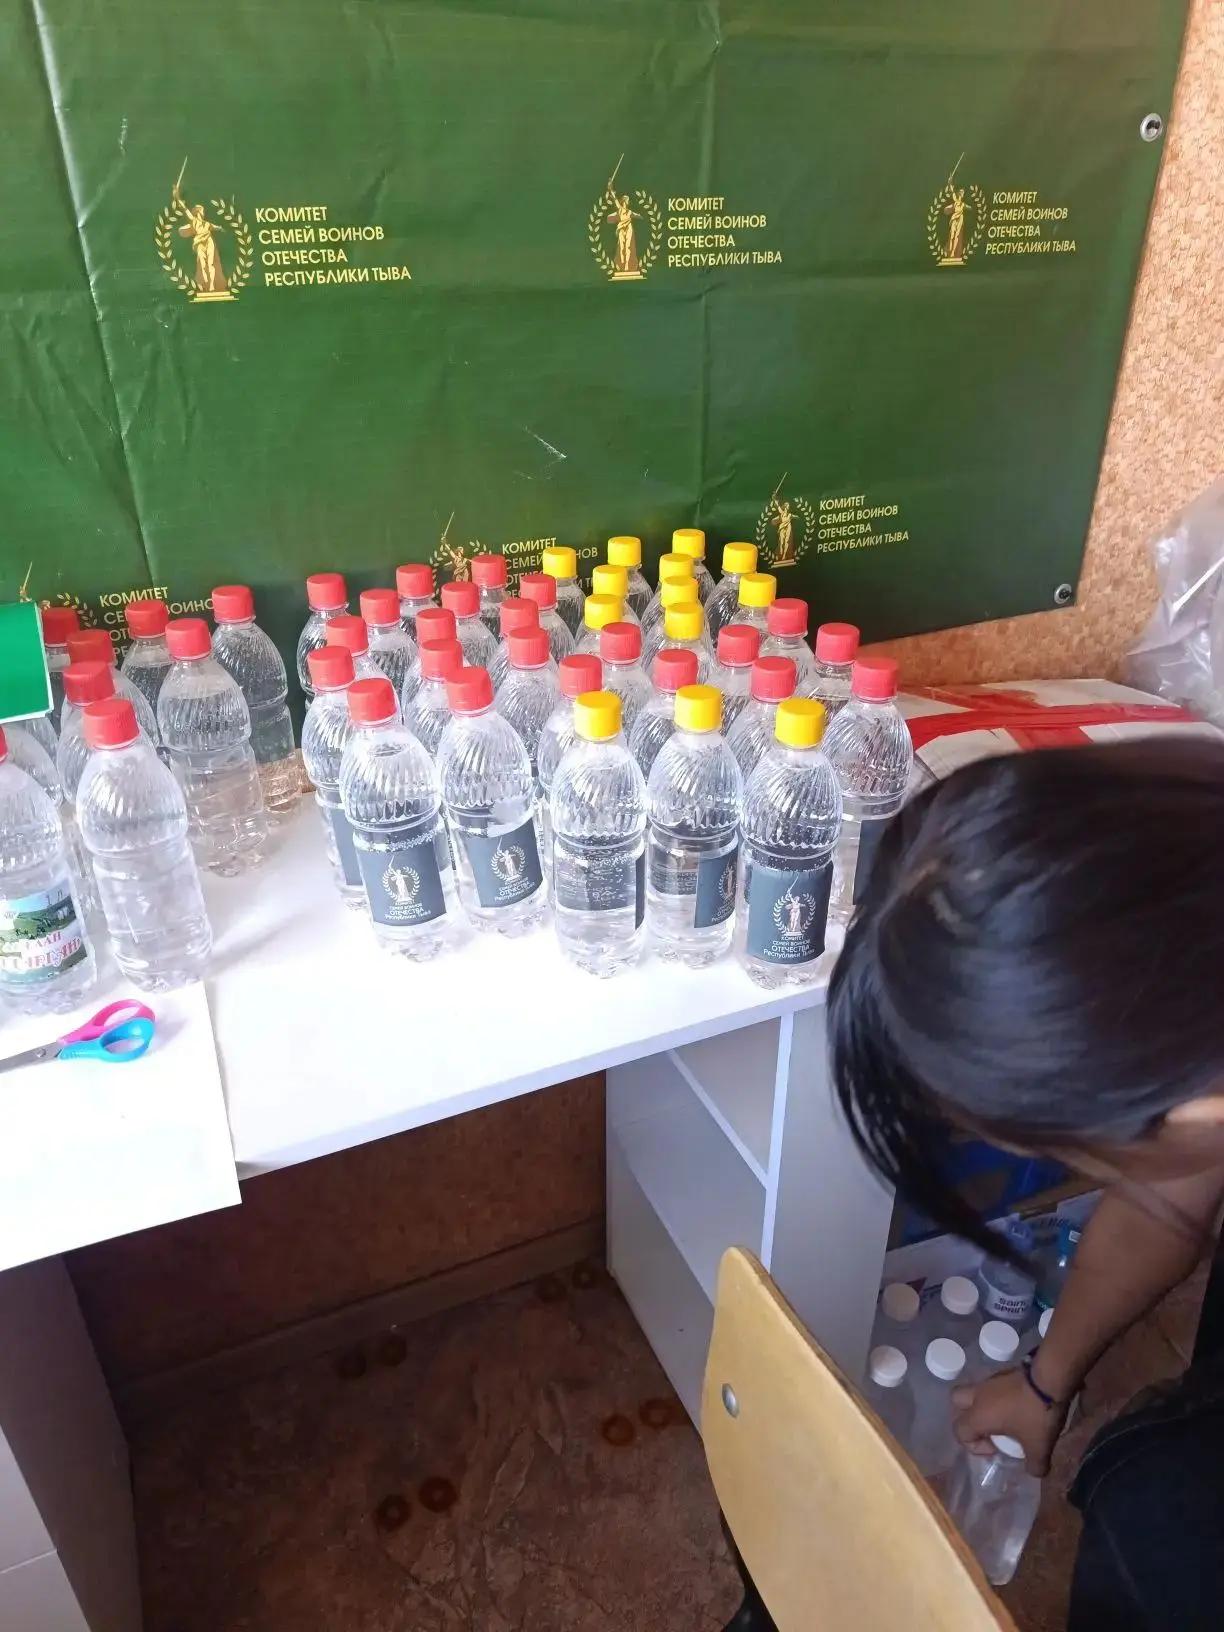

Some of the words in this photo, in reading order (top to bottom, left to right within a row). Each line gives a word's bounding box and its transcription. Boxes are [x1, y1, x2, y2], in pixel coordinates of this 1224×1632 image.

[668, 197, 725, 212] КОМИТЕТ
[992, 191, 1038, 204] КОМИТЕТ
[255, 206, 327, 223] КОМИТЕТ
[667, 213, 712, 230] СЕМЕЙ
[714, 215, 767, 229] ВОИНОВ
[990, 206, 1025, 221] СЕМЕЙ
[1026, 207, 1069, 220] ВОИНОВ
[258, 225, 315, 245] СЕМЕЙ
[318, 226, 385, 241] ВОИНОВ
[987, 225, 1041, 238] ОТЕЧЕСТВА
[667, 234, 736, 249] ОТЕЧЕСТВА
[985, 240, 1051, 255] РЕСПУБЛИКИ
[1052, 240, 1076, 252] ТЫВА
[261, 248, 348, 266] ОТЕЧЕСТВА
[668, 252, 750, 268] РЕСПУБЛИКИ
[751, 251, 783, 264] ТЫВА
[264, 267, 369, 287] РЕСПУБЛИКИ
[371, 266, 412, 281] ТЫВА
[819, 495, 866, 511] КОМИТЕТ
[818, 509, 855, 525] СЕМЕЙ
[856, 505, 899, 520] ВОИНОВ
[817, 522, 872, 540] ОТЕЧЕСТВА
[501, 537, 557, 555] КОМИТЕТ
[817, 534, 882, 554] РЕСПУБЛИКИ
[884, 530, 909, 543] ТЫВА
[99, 586, 168, 608] КОМИТЕТ
[771, 944, 810, 953] ОТЕЧЕСТВА
